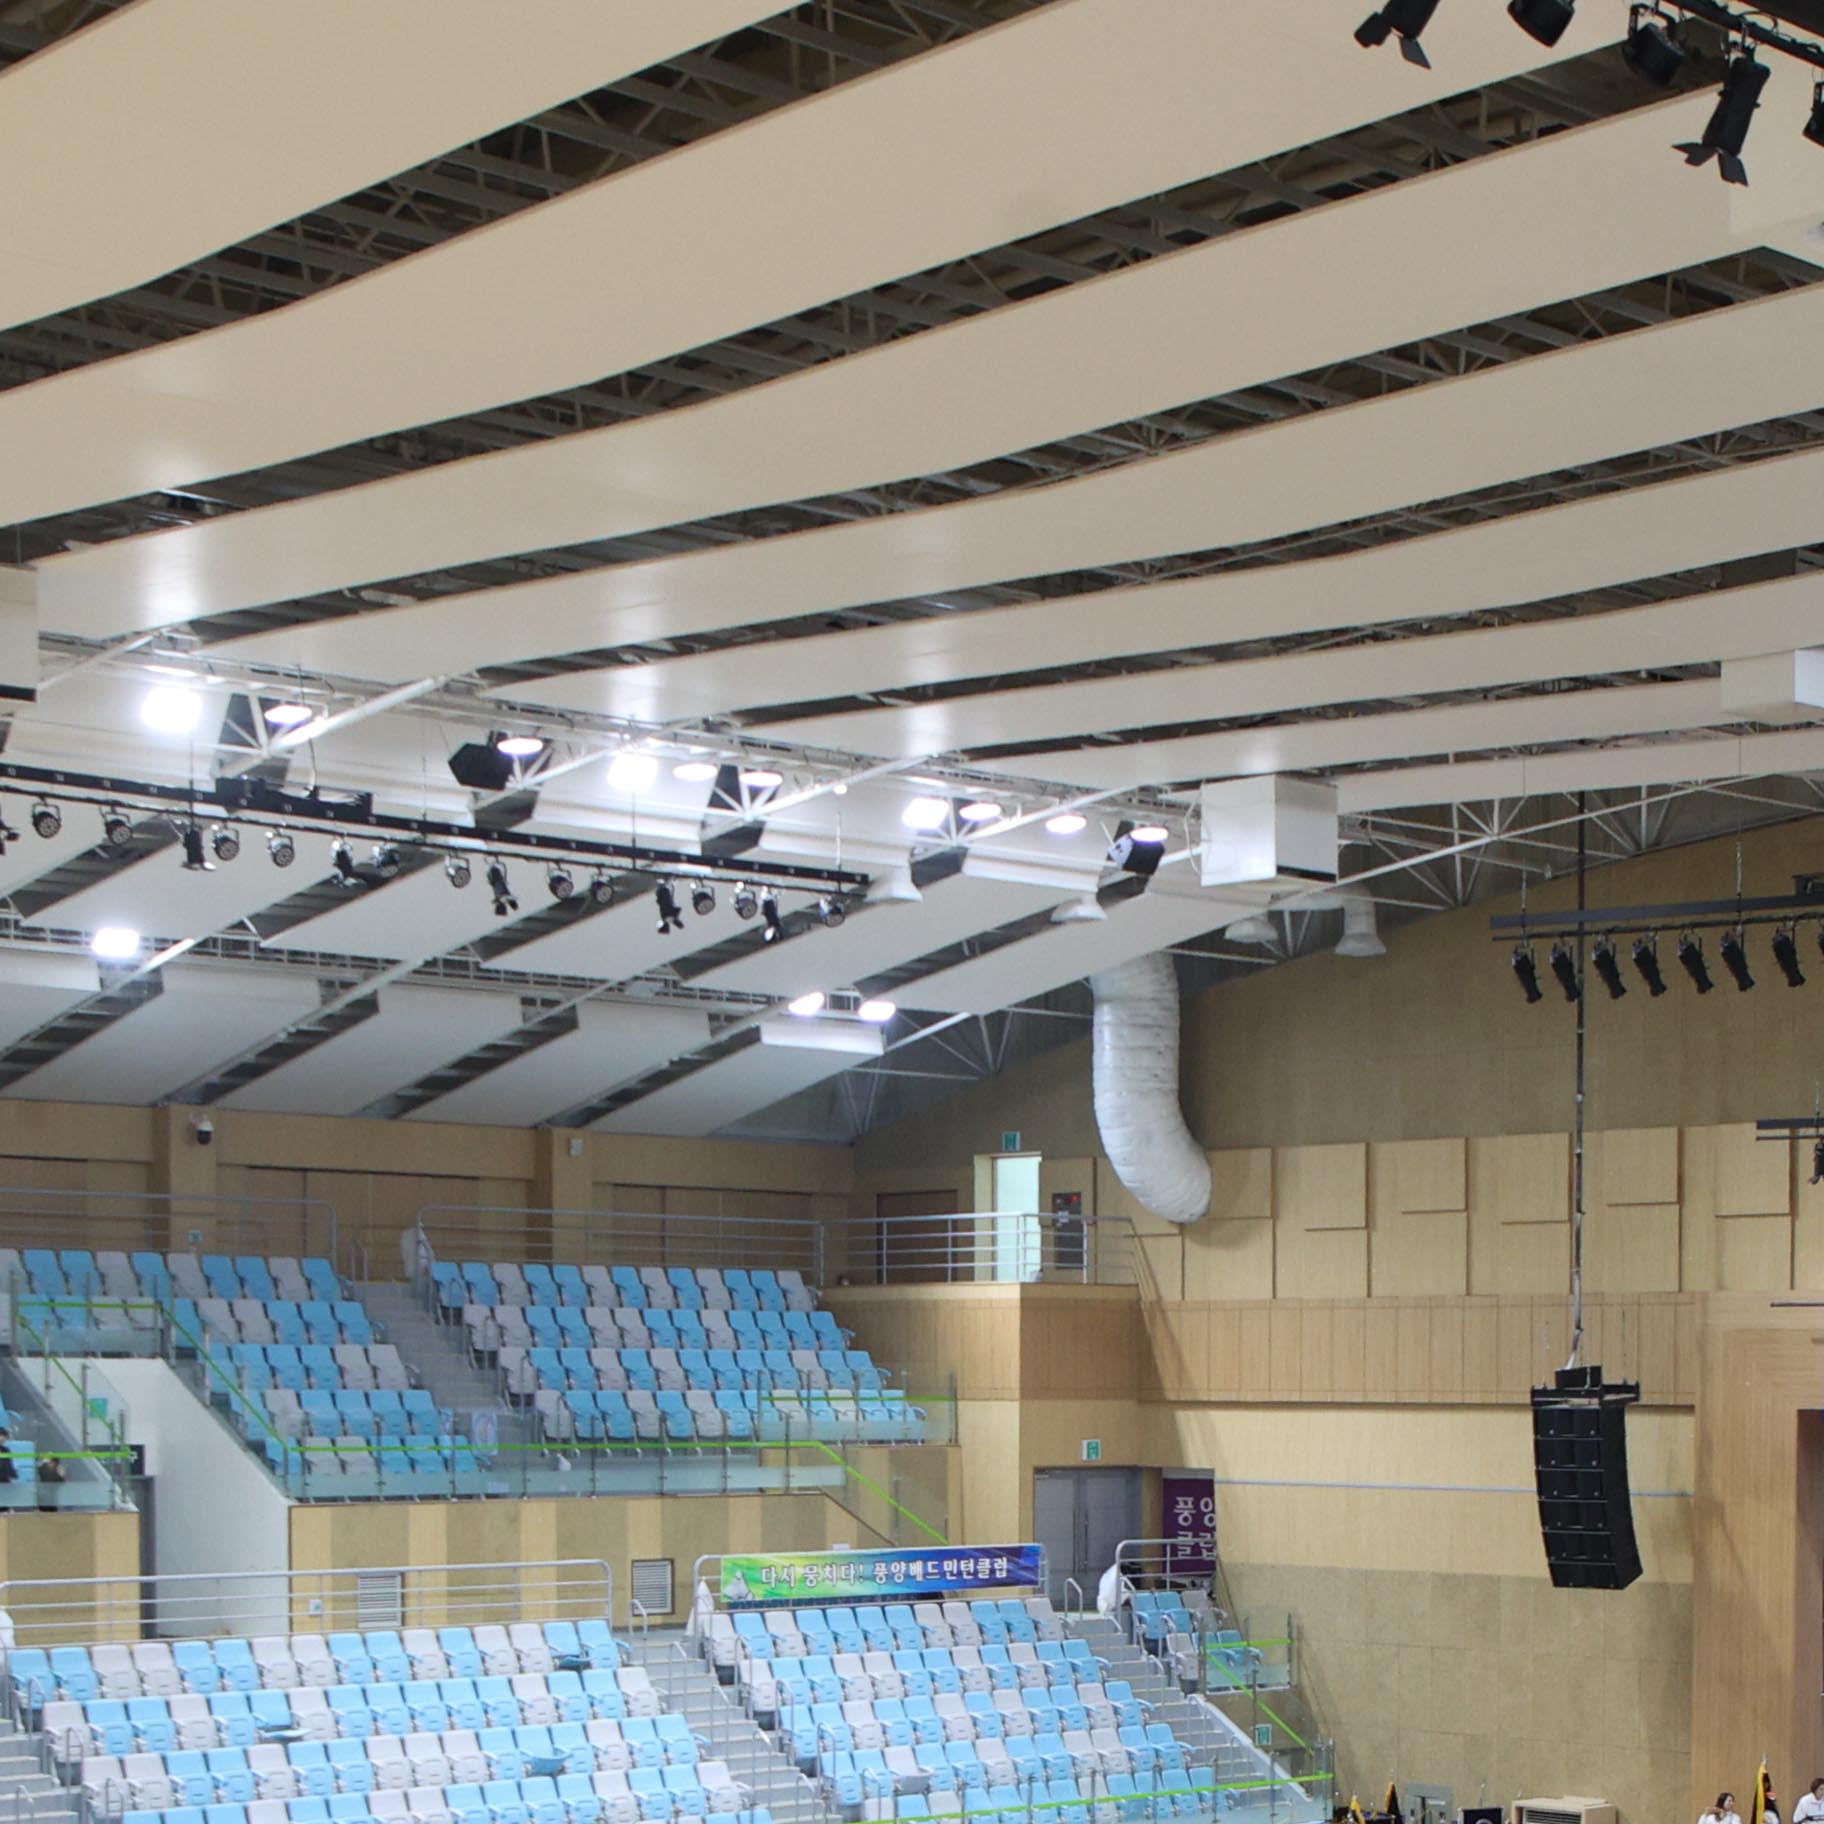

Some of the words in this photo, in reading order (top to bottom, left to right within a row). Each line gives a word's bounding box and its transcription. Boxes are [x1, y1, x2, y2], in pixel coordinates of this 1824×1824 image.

[760, 1566, 797, 1589] 다시
[802, 1563, 867, 1587] 뭉치다!
[871, 1556, 1010, 1585] 풍양배드민턴클럽
